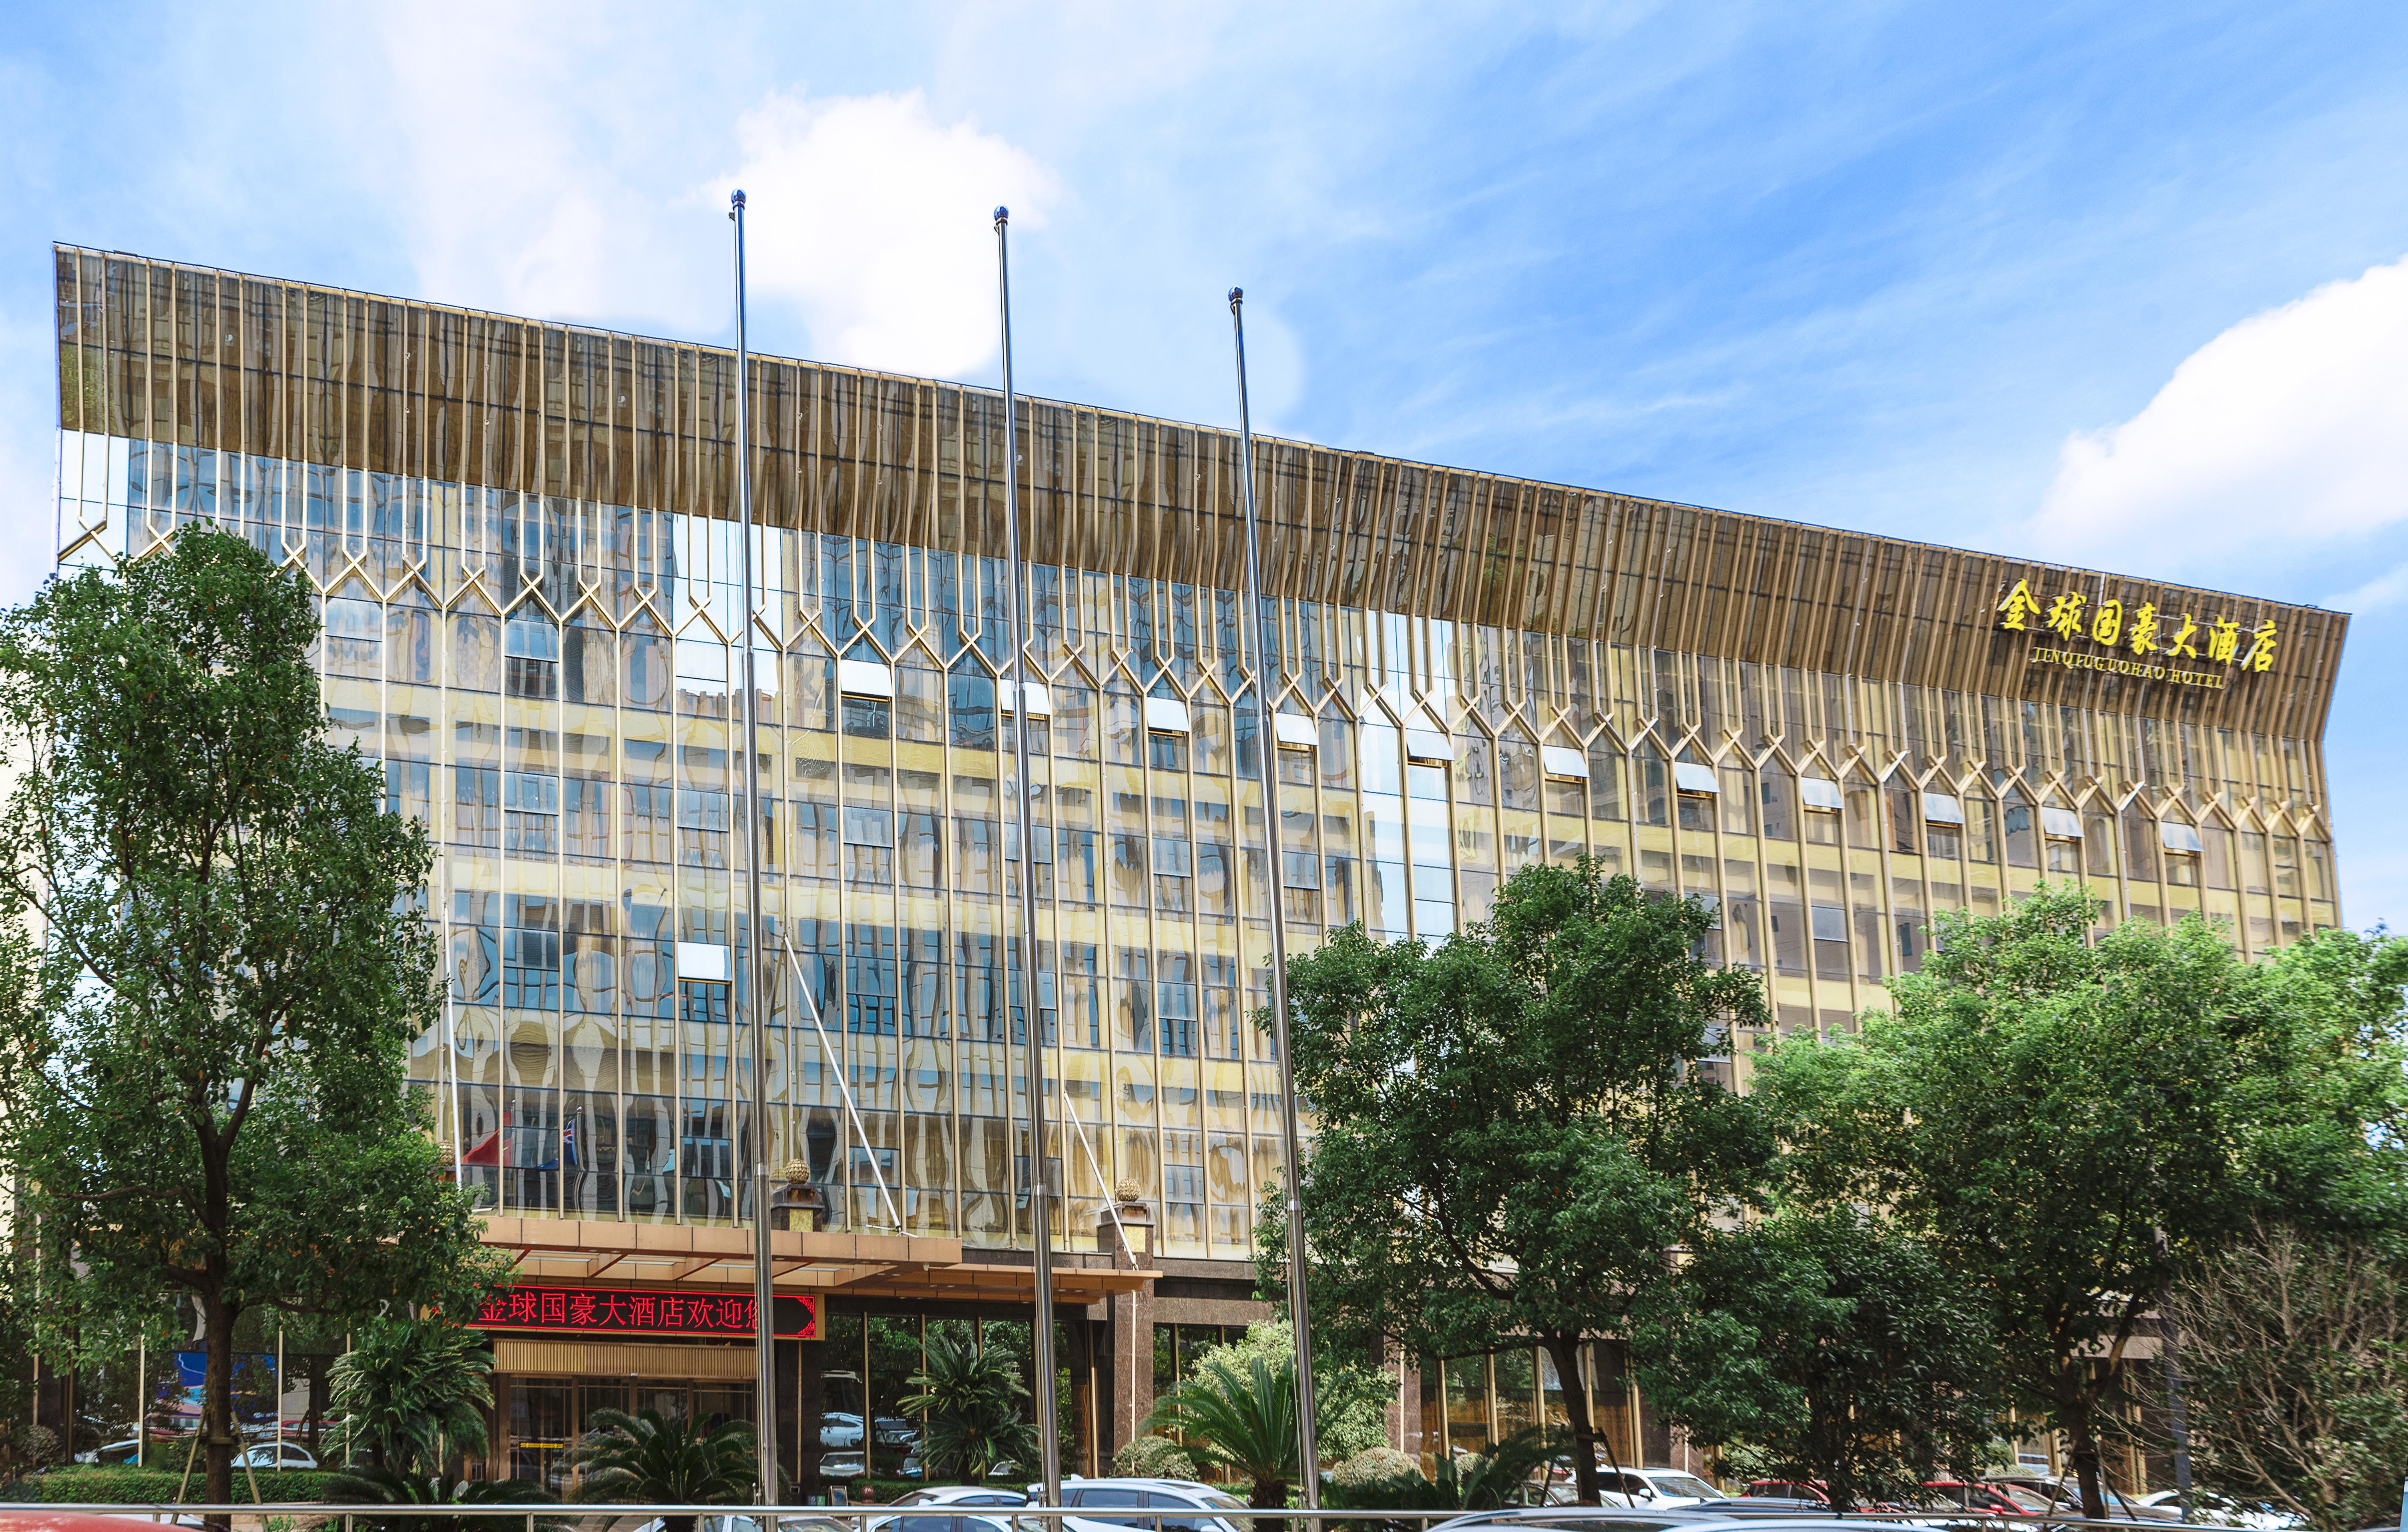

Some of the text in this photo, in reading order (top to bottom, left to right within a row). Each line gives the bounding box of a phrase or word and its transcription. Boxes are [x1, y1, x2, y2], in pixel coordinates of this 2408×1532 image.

[2000, 578, 2277, 672] 金球国豪大酒店
[2031, 647, 2223, 688] JINQIUGUOHAO HOTEL
